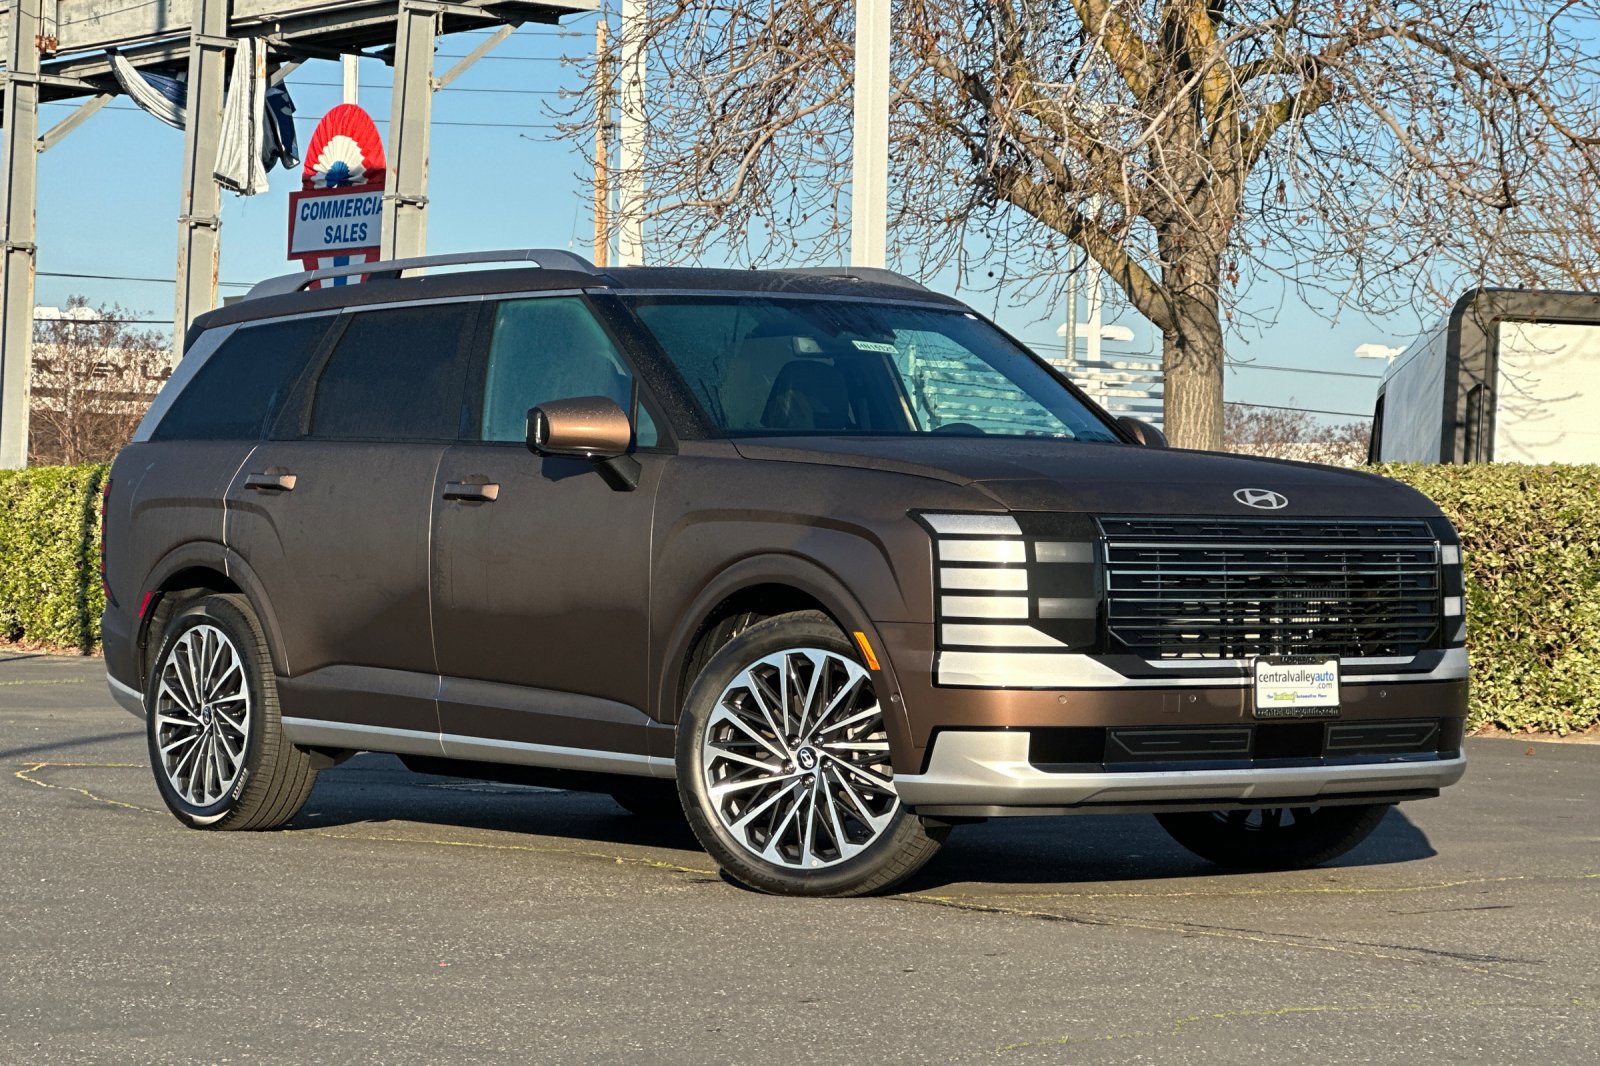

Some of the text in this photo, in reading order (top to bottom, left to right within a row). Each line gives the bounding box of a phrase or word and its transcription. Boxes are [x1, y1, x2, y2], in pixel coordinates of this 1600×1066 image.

[301, 196, 383, 221] COMMERCIA
[324, 222, 368, 244] SALES
[1258, 670, 1335, 685] centralvalleyauto
